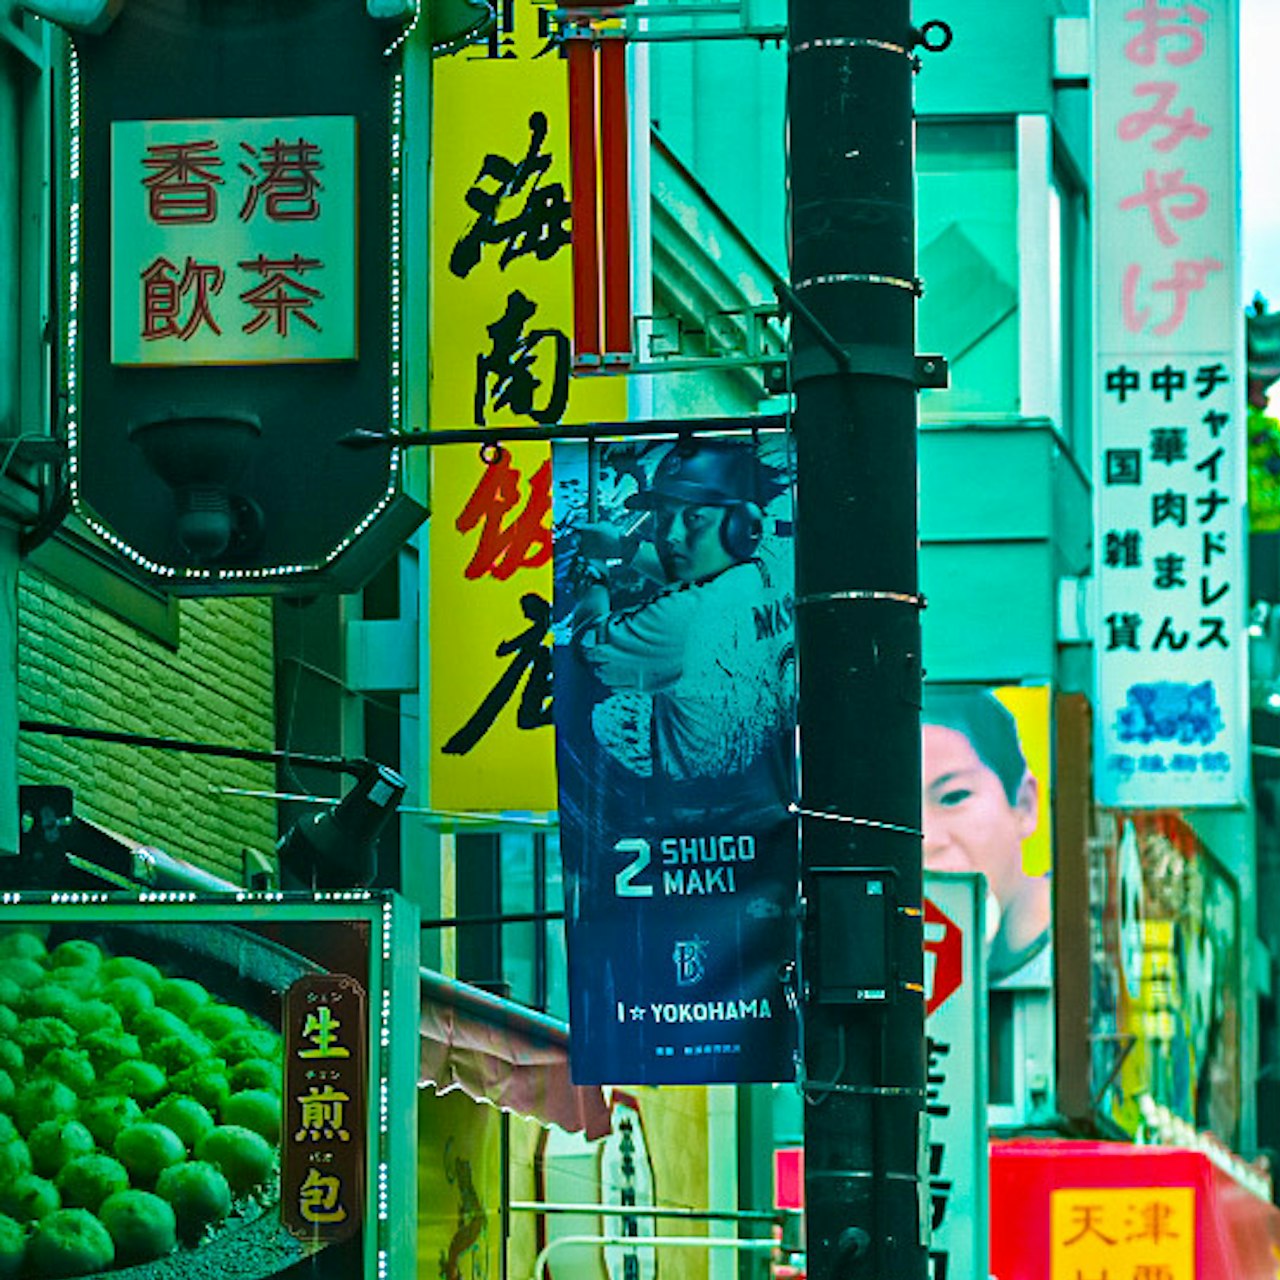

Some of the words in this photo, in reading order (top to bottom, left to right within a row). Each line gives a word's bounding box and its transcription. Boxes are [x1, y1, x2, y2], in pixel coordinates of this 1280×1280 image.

[141, 136, 323, 225] 香港
[1117, 0, 1223, 336] おみやげ
[139, 253, 325, 341] 飲茶
[1104, 365, 1141, 652] 中国雑貨
[1150, 365, 1188, 651] 中華肉まん
[1195, 363, 1230, 649] チャイナドレス
[613, 838, 653, 897] 2
[661, 836, 755, 864] SHUGO
[663, 867, 735, 896] MAKI
[651, 999, 771, 1023] YOKOHAMA
[295, 1006, 350, 1223] 生煎包
[1063, 1200, 1180, 1246] 天津
